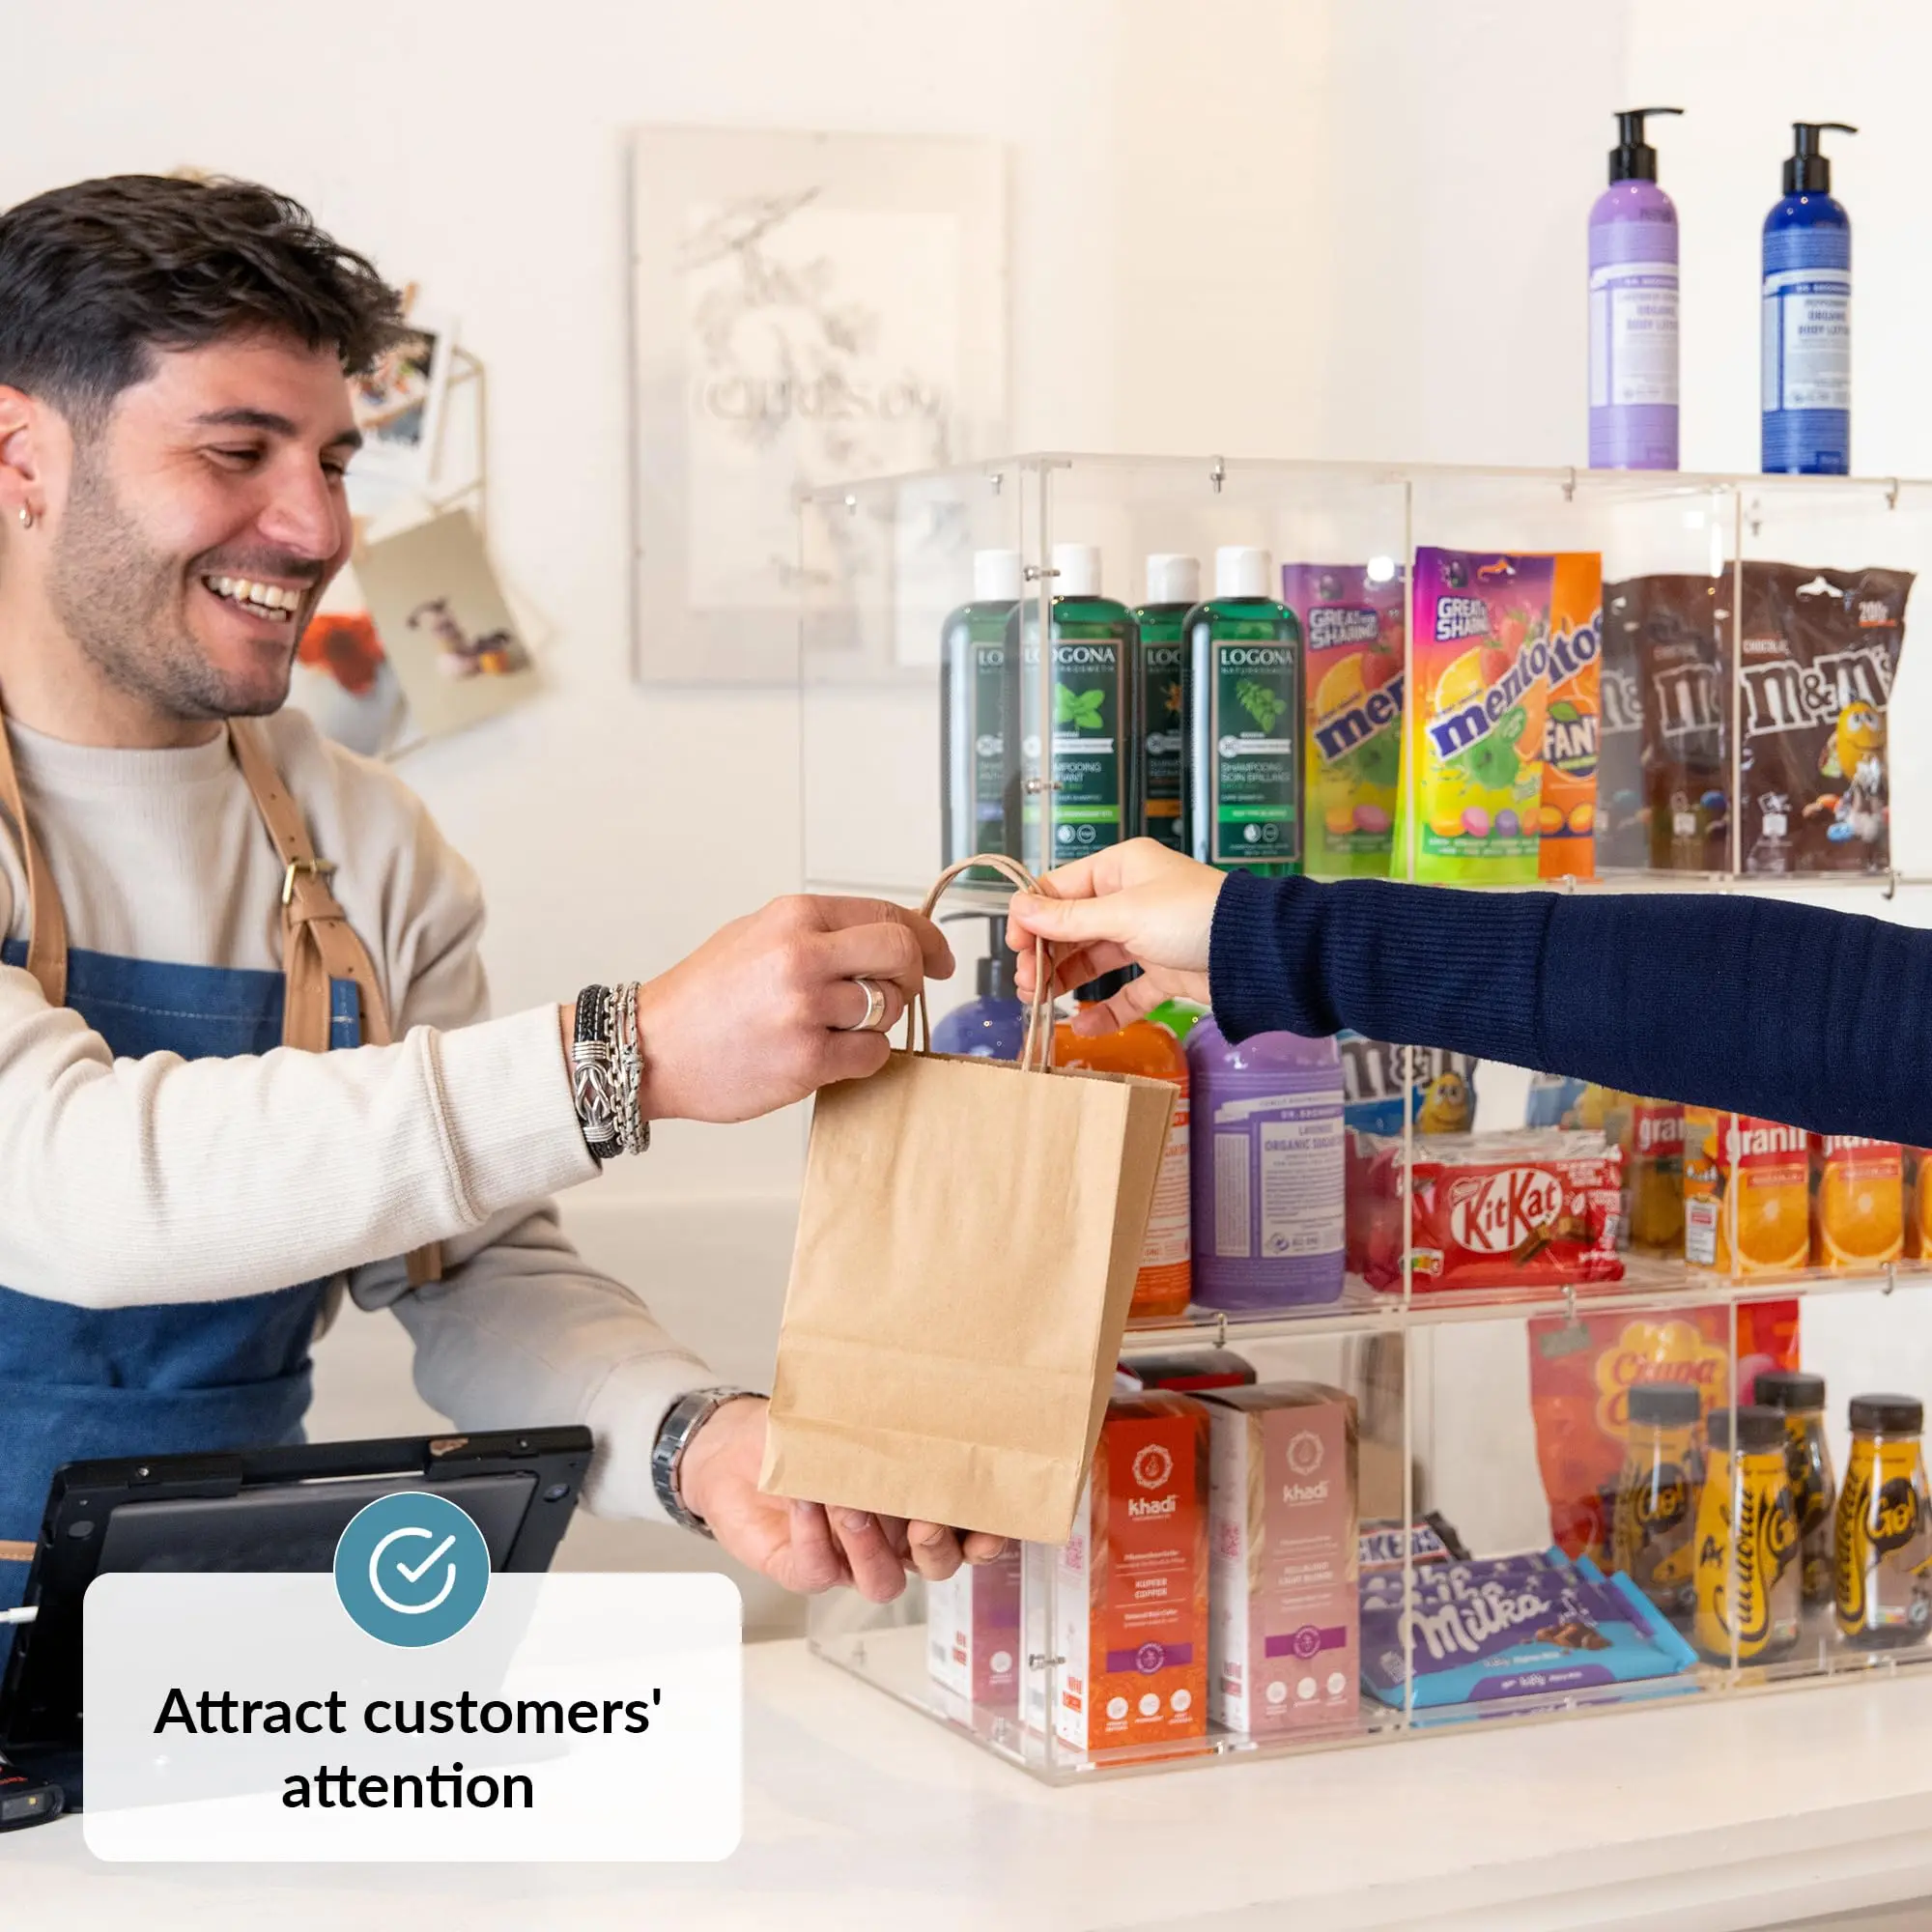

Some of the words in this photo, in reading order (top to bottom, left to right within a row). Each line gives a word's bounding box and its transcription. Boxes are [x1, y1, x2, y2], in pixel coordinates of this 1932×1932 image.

[1221, 648, 1293, 666] LOGONA
[1463, 1171, 1557, 1249] KitKat
[1127, 1496, 1178, 1517] khadi
[1283, 1485, 1328, 1504] khadi
[1867, 1488, 1917, 1540] Go!
[1399, 1593, 1551, 1660] Milka
